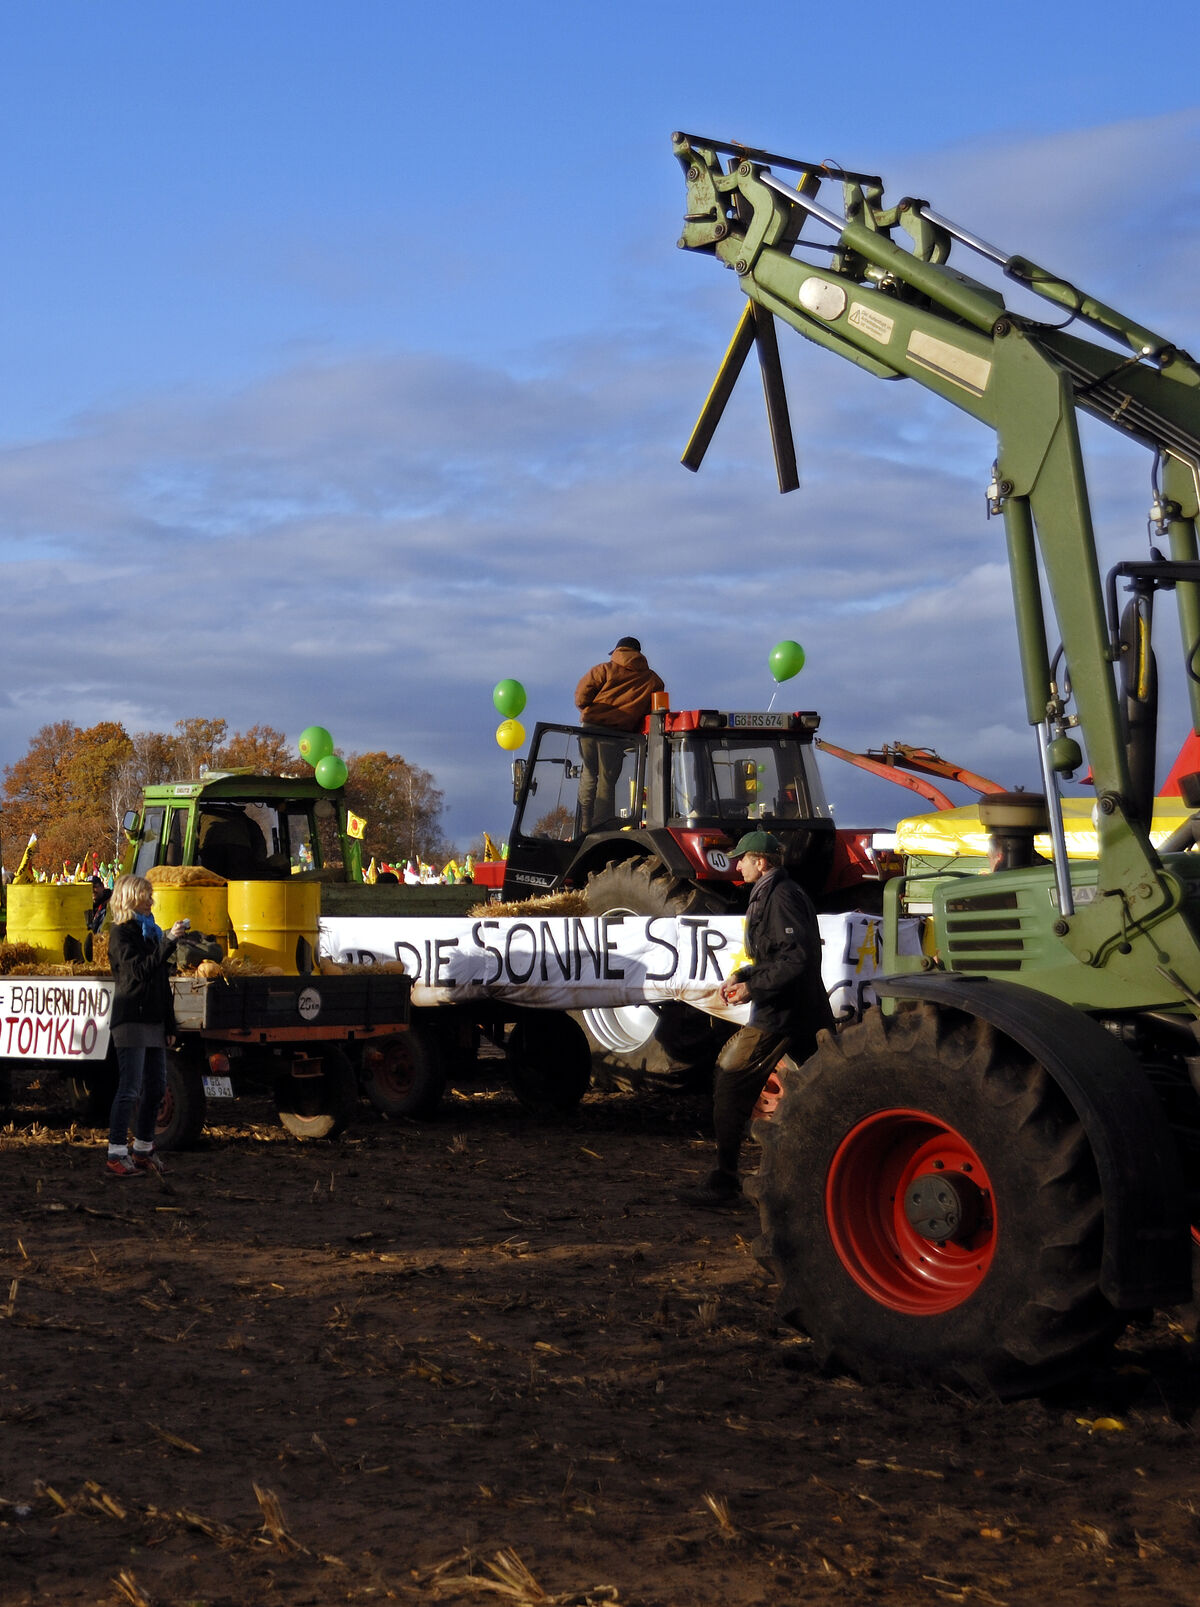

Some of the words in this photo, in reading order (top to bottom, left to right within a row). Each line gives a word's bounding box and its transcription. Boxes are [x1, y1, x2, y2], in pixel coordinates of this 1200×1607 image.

[765, 715, 782, 726] 674
[710, 852, 726, 868] 40
[394, 938, 460, 988] DIE
[471, 916, 625, 986] SONNE
[11, 985, 113, 1017] BAUERNLAND
